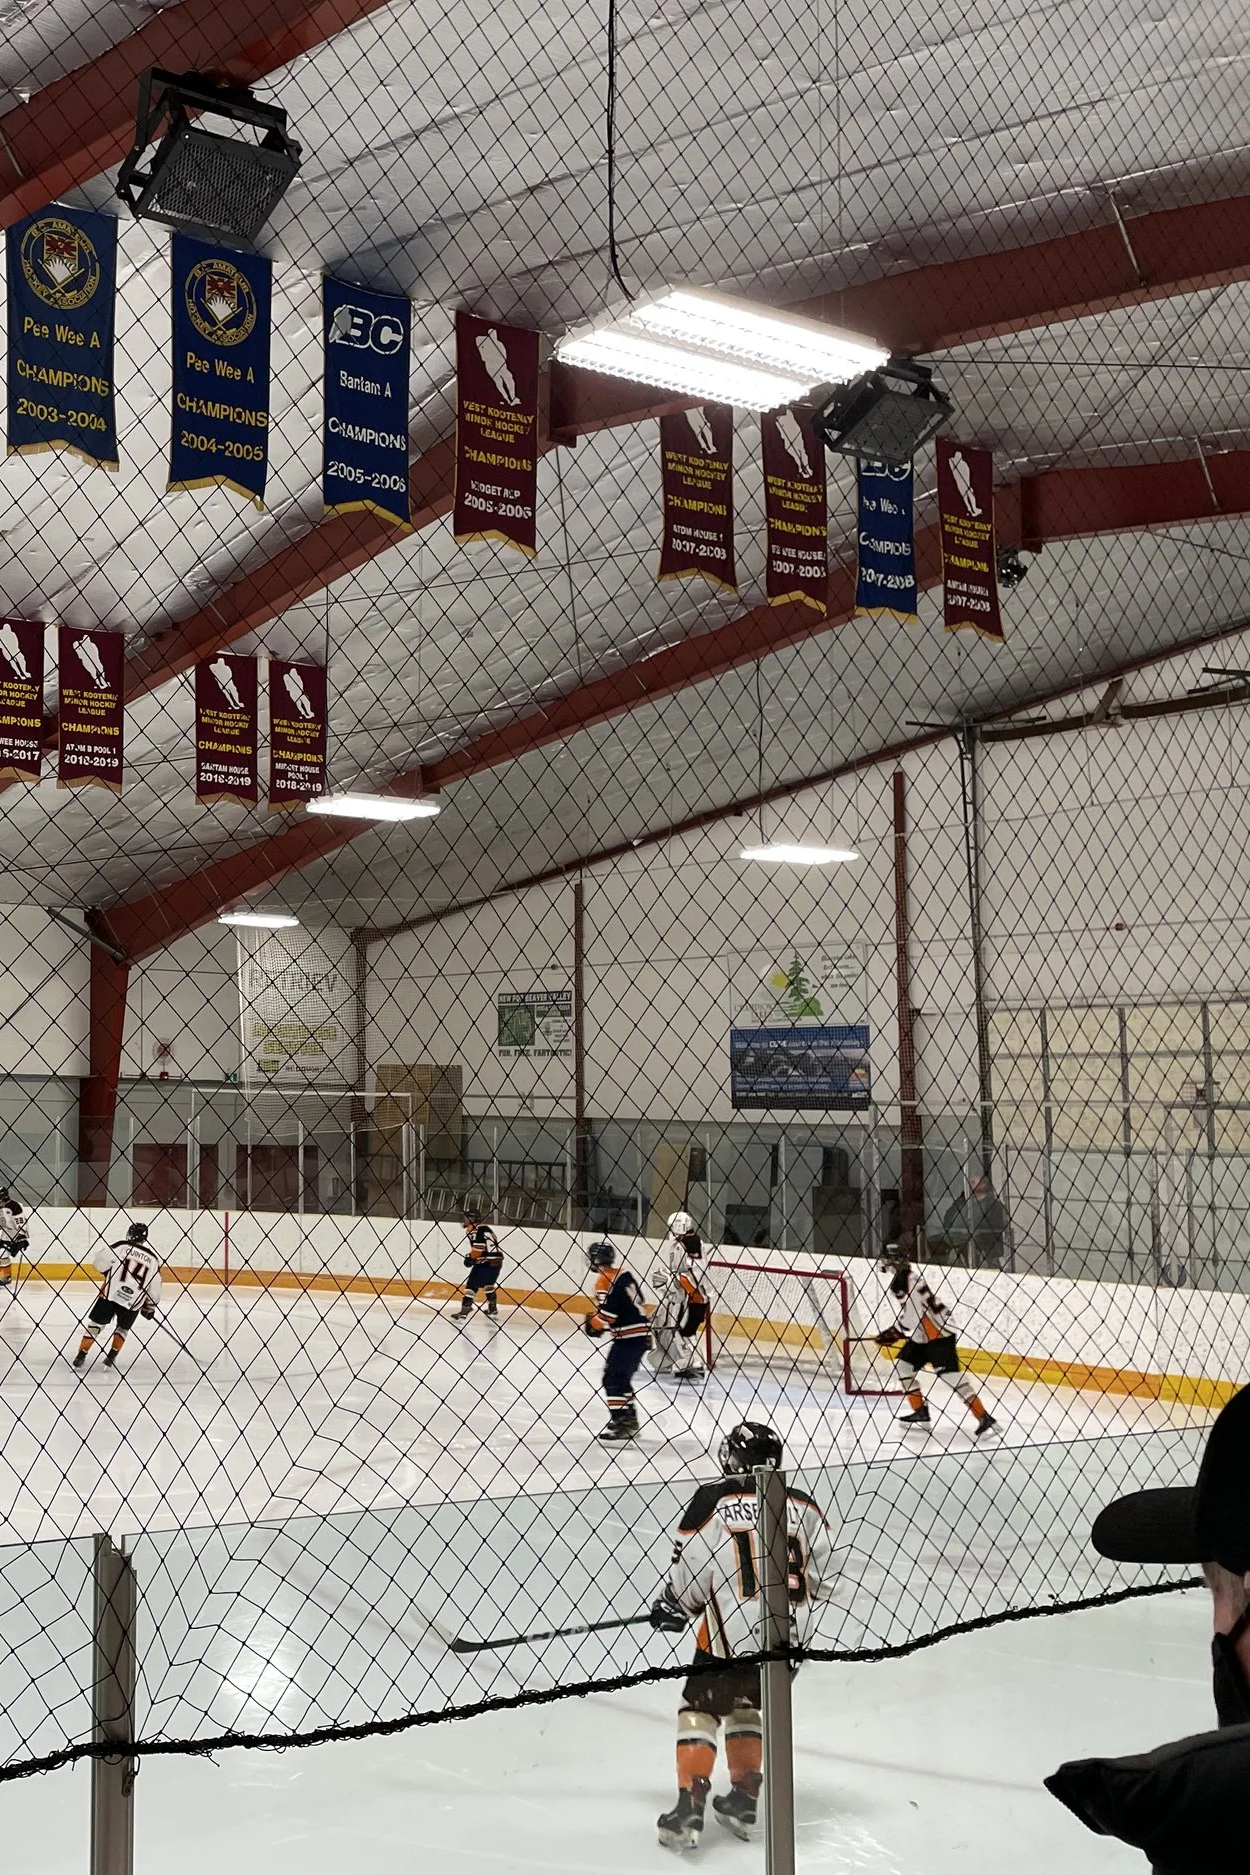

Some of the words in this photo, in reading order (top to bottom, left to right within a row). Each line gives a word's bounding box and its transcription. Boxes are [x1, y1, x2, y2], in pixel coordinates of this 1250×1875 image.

[24, 317, 50, 339] Pee
[55, 324, 85, 346] Wee
[90, 331, 100, 348] A
[16, 359, 110, 397] CHAMPIONS
[186, 351, 210, 374] Pee
[215, 359, 242, 380] Wee
[246, 367, 255, 384] A
[339, 370, 381, 396] Bantam
[384, 381, 392, 399] A
[16, 398, 107, 432] 2003-2004
[176, 392, 268, 428] CHAMPIONS
[181, 430, 264, 462] 2004-2005
[328, 416, 406, 451] CHAMPIONS
[464, 445, 532, 471] CHAMPIONS
[326, 460, 406, 493] 2005-2006
[62, 722, 120, 736] CHAMPIONS
[198, 741, 252, 754] CHAMPIONS
[273, 750, 324, 763] CHAMPIONS
[120, 1259, 149, 1290] 14
